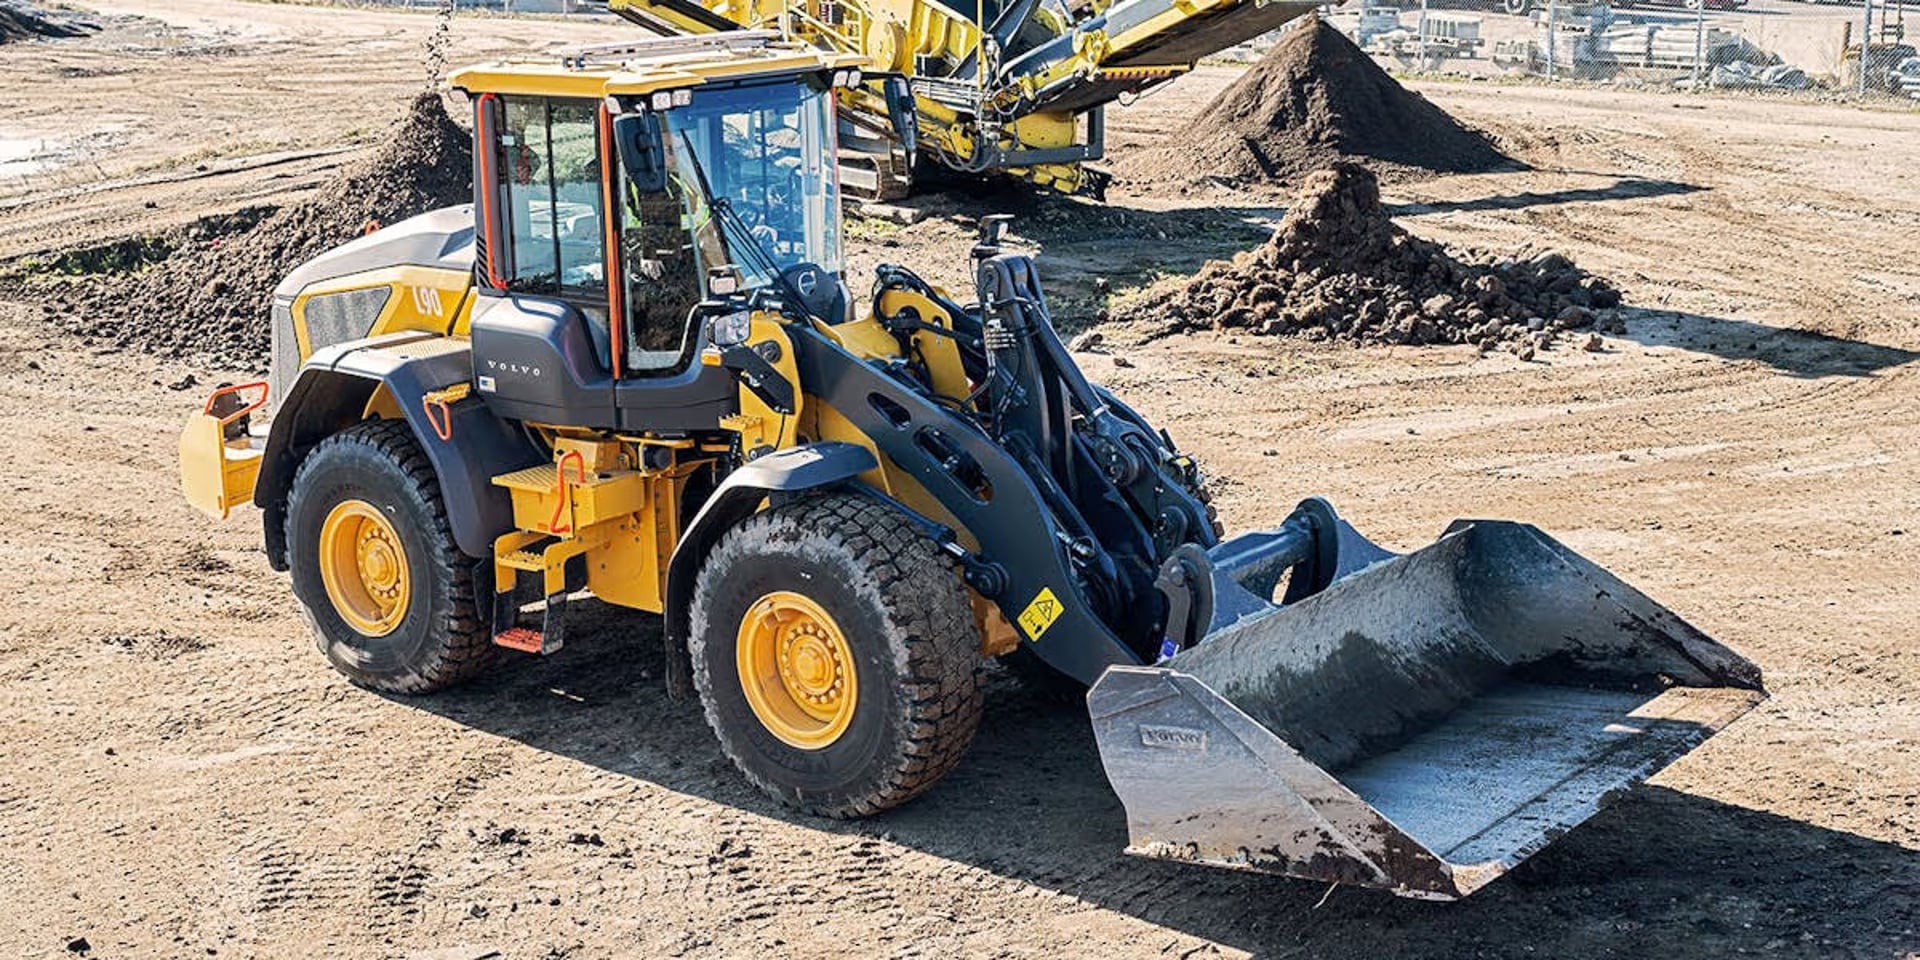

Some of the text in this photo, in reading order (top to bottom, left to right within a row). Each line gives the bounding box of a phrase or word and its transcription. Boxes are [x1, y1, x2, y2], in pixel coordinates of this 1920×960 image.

[412, 284, 443, 317] L90
[487, 360, 540, 376] VOLVO
[1145, 728, 1200, 744] VOLVO
